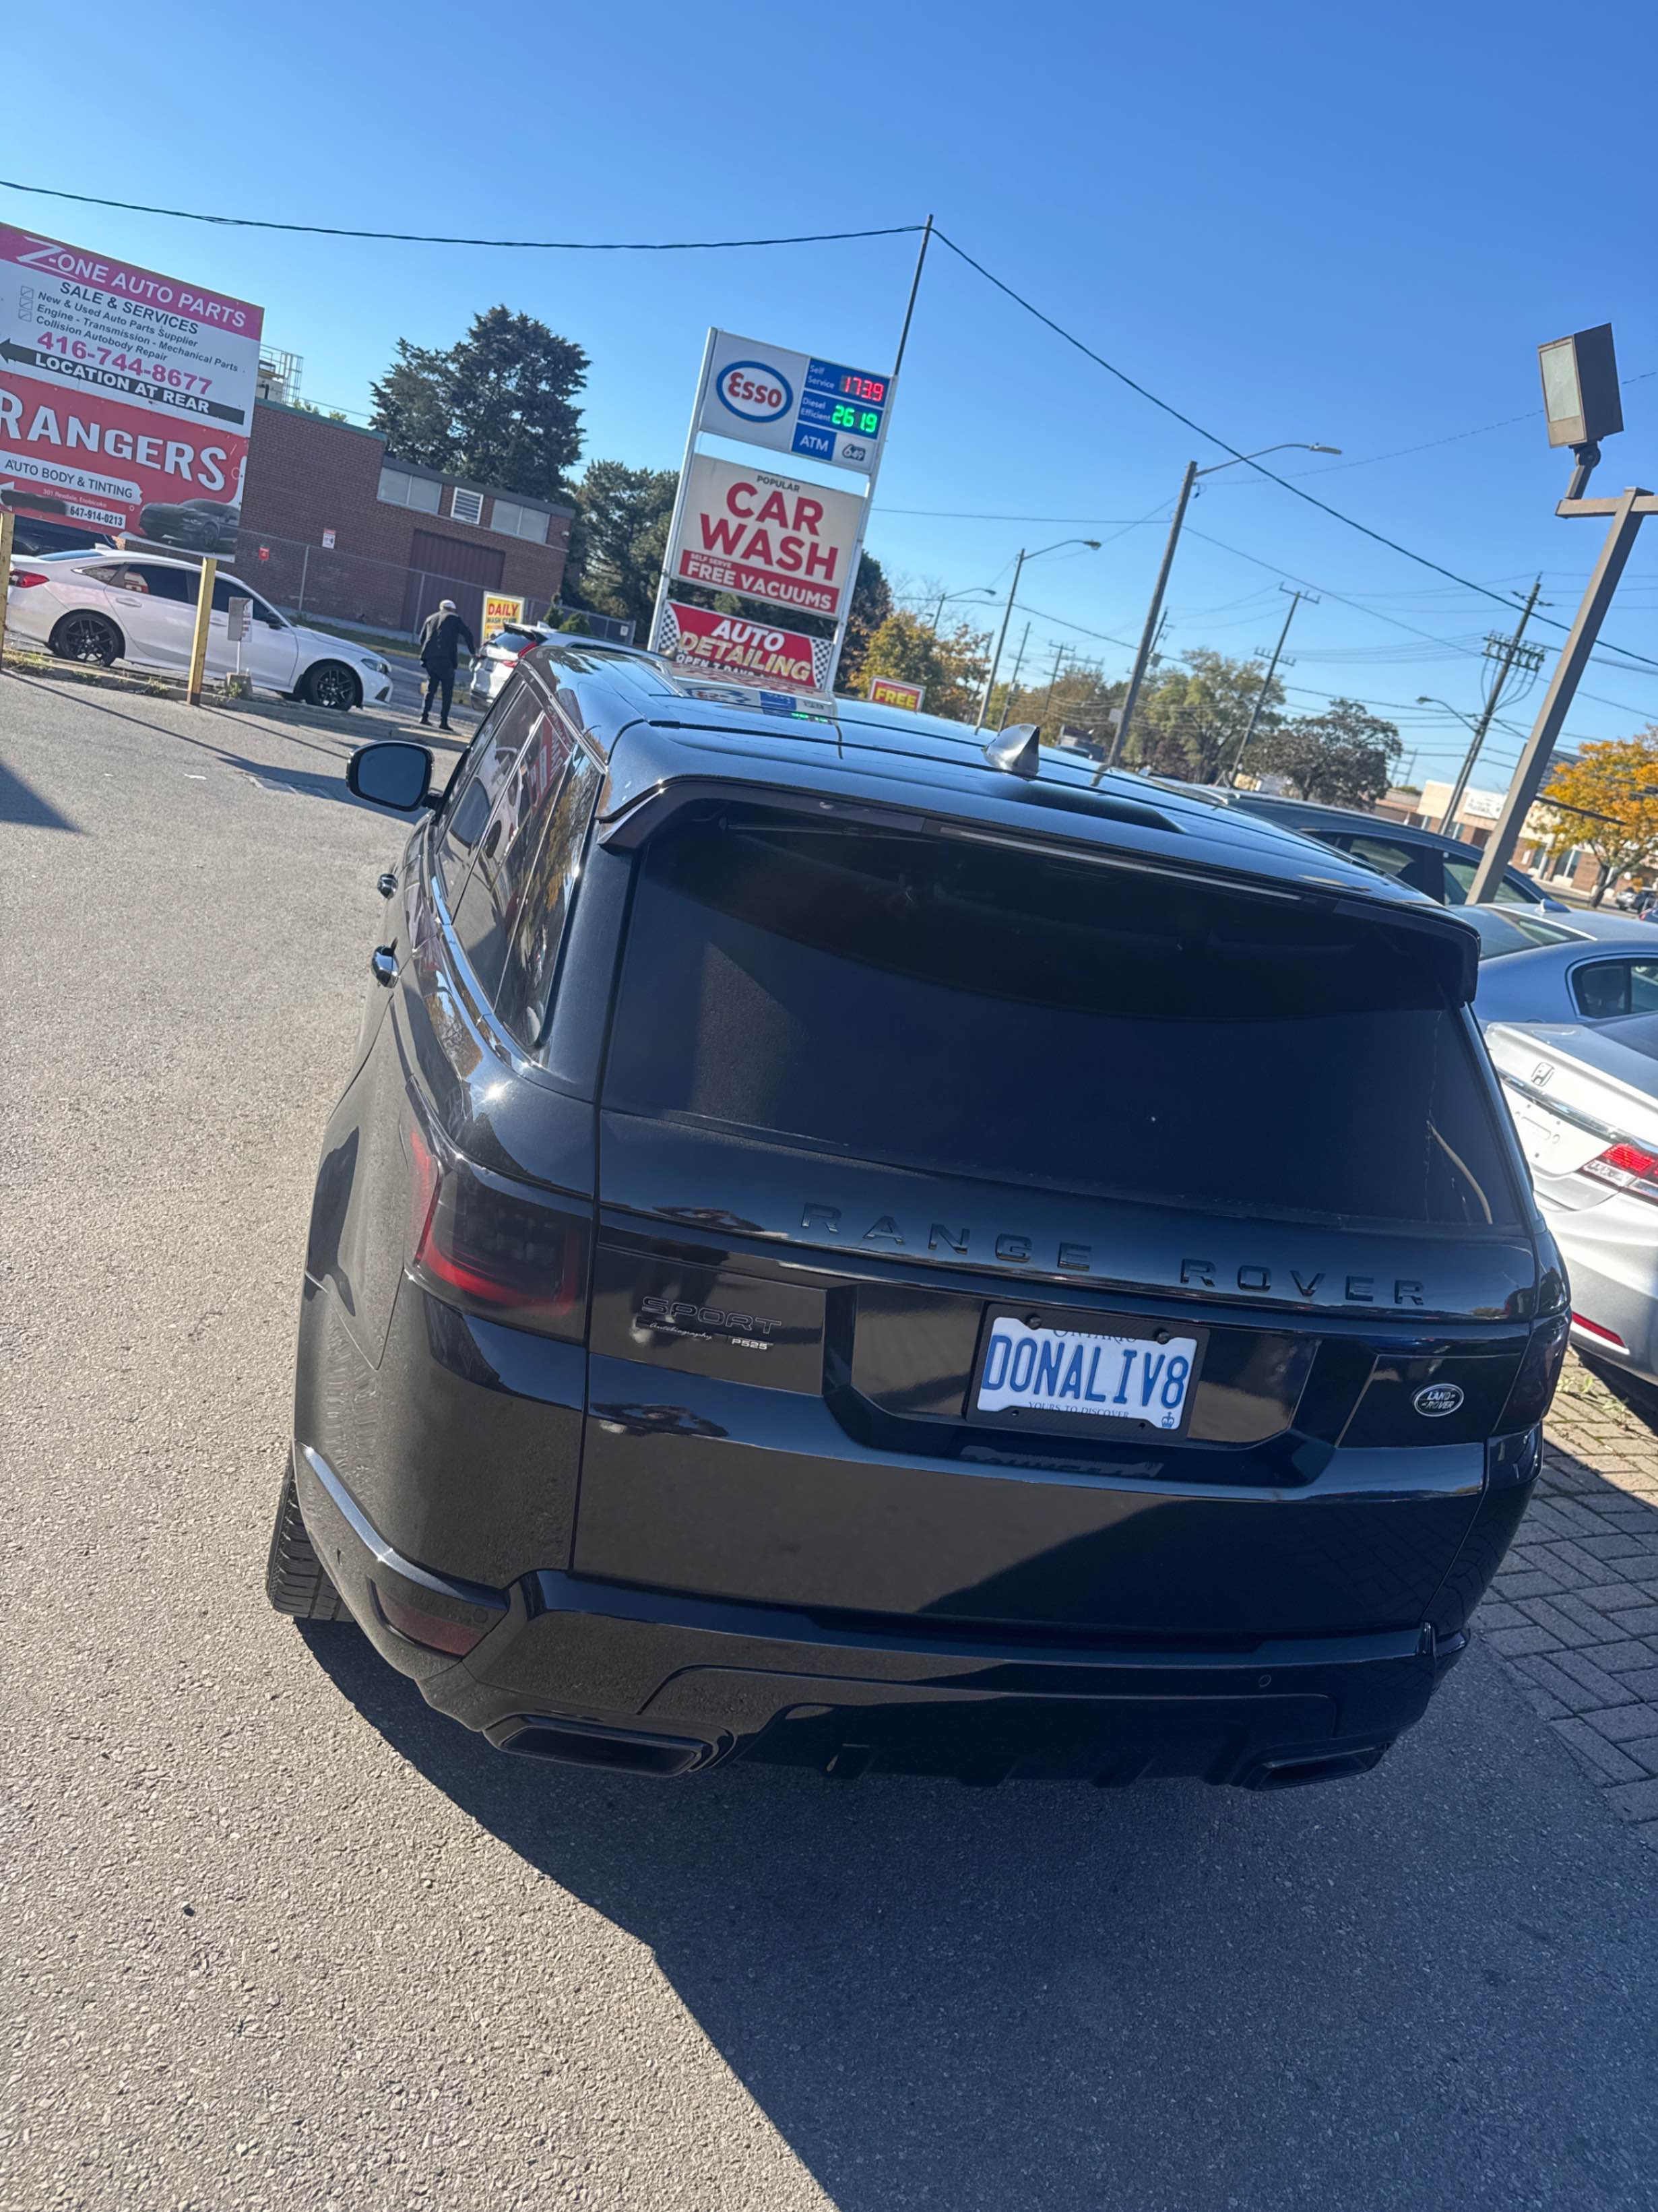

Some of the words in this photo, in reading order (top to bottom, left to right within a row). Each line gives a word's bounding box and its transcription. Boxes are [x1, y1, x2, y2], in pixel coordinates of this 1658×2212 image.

[38, 291, 61, 305] New
[64, 299, 71, 309] &
[75, 303, 101, 317] Used
[102, 312, 127, 325] Auto
[129, 320, 155, 334] Parts
[158, 328, 198, 347] Supplier
[60, 282, 104, 305] SALE
[107, 296, 118, 309] &
[123, 301, 199, 334] SERVICES
[111, 272, 173, 303] AUTO
[178, 292, 247, 327] PARTS
[36, 315, 82, 336] Collision
[84, 331, 133, 352] Autobody
[135, 346, 168, 361] Repair
[37, 304, 74, 321] Engine
[84, 317, 150, 344] Transmission
[158, 341, 213, 364] Mechanical
[214, 358, 238, 372] Parts
[37, 331, 213, 395] 416-744-8677
[808, 375, 835, 389] Service
[36, 353, 130, 391] LOCATION
[135, 383, 159, 398] AT
[162, 392, 210, 414] REAR
[800, 406, 831, 422] Efficient
[802, 398, 826, 410] Diesel
[0, 388, 228, 491] RANGERS
[800, 435, 829, 453] ATM
[5, 459, 38, 476] AUTO
[42, 468, 75, 484] BODY
[77, 476, 86, 487] &
[88, 478, 133, 499] TINTING
[757, 474, 800, 493] POPULAR
[69, 506, 123, 526] 647-914-0213
[726, 482, 824, 536] CAR
[700, 513, 839, 581] WASH
[687, 561, 736, 587] FREE
[741, 574, 832, 610] VACUUMS
[488, 603, 519, 617] DAILY
[711, 620, 784, 652] AUTO
[676, 654, 709, 668] OPEN
[875, 687, 916, 708] FREE
[800, 1201, 1092, 1272] RANGE
[1180, 1258, 1424, 1306] ROVER
[641, 1296, 782, 1334] SPORT
[649, 1322, 713, 1341] Autobiography
[732, 1338, 768, 1350] P525
[981, 1334, 1189, 1409] DONALIV8
[1065, 1405, 1079, 1413] TO
